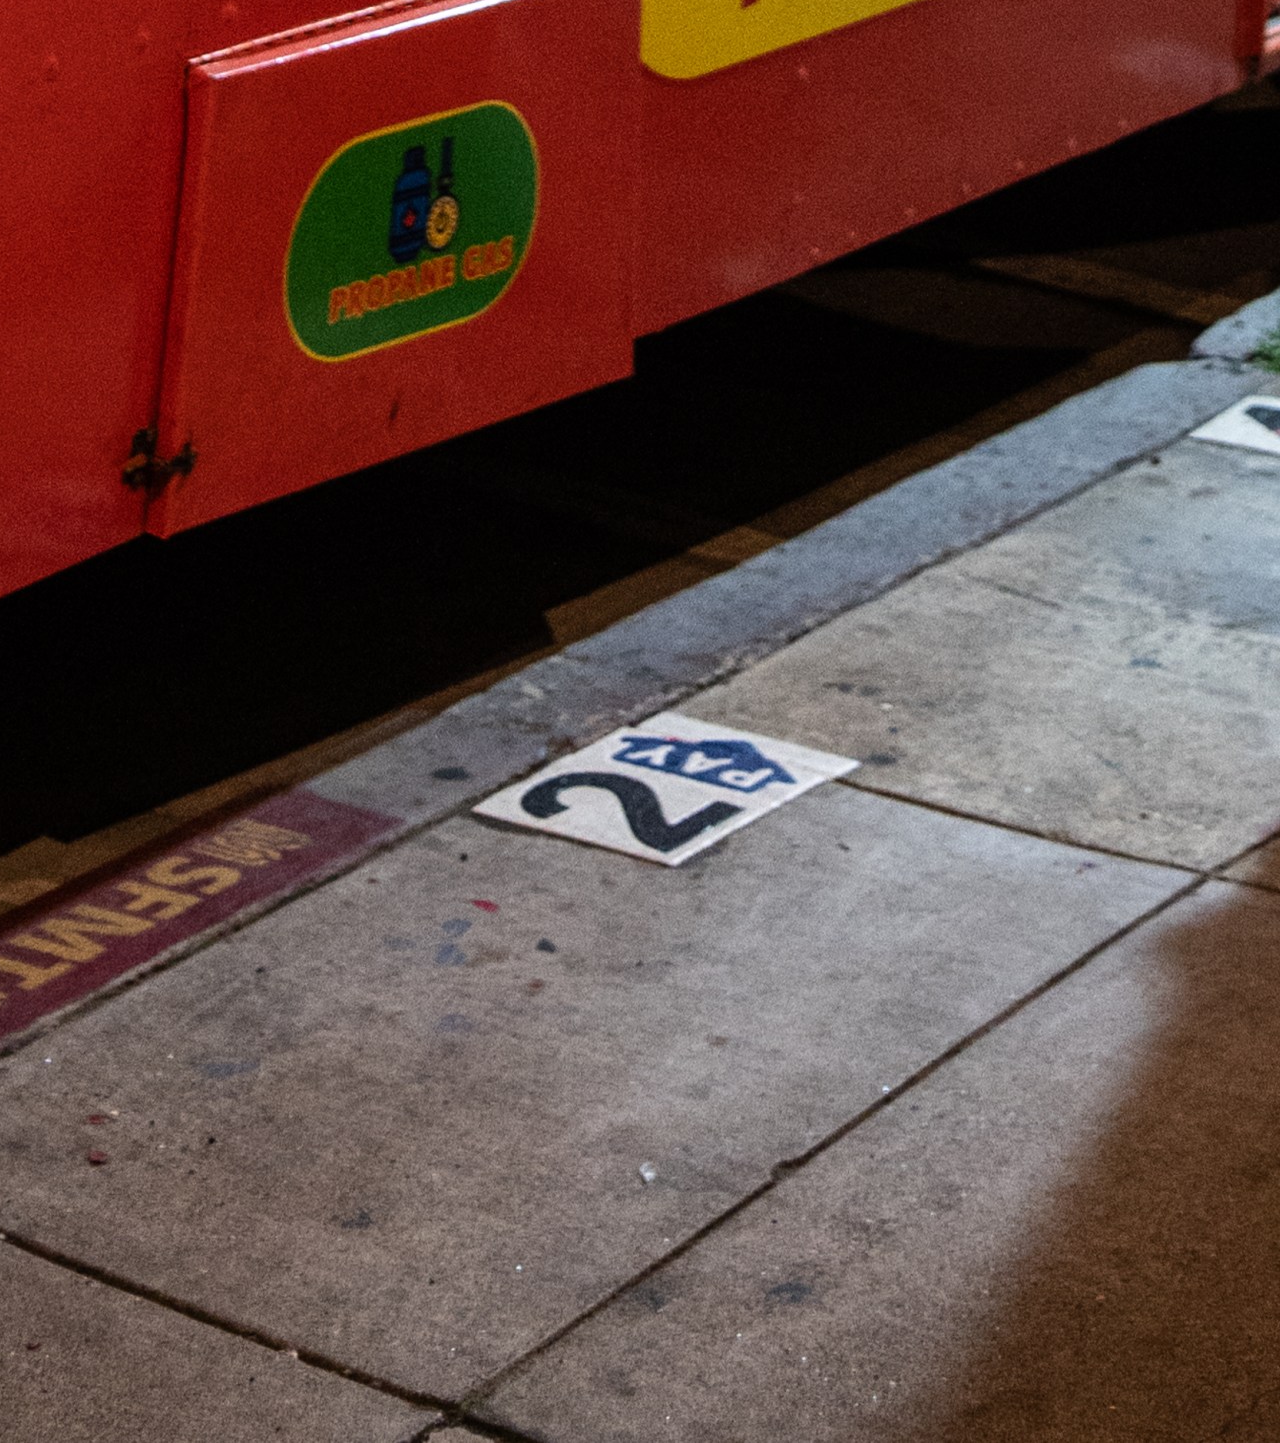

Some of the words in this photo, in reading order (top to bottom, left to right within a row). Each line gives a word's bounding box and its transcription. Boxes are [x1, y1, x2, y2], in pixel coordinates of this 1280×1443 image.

[327, 255, 456, 326] PROPANE
[462, 235, 515, 282] GAS
[622, 744, 775, 787] PAY
[521, 772, 745, 853] 2
